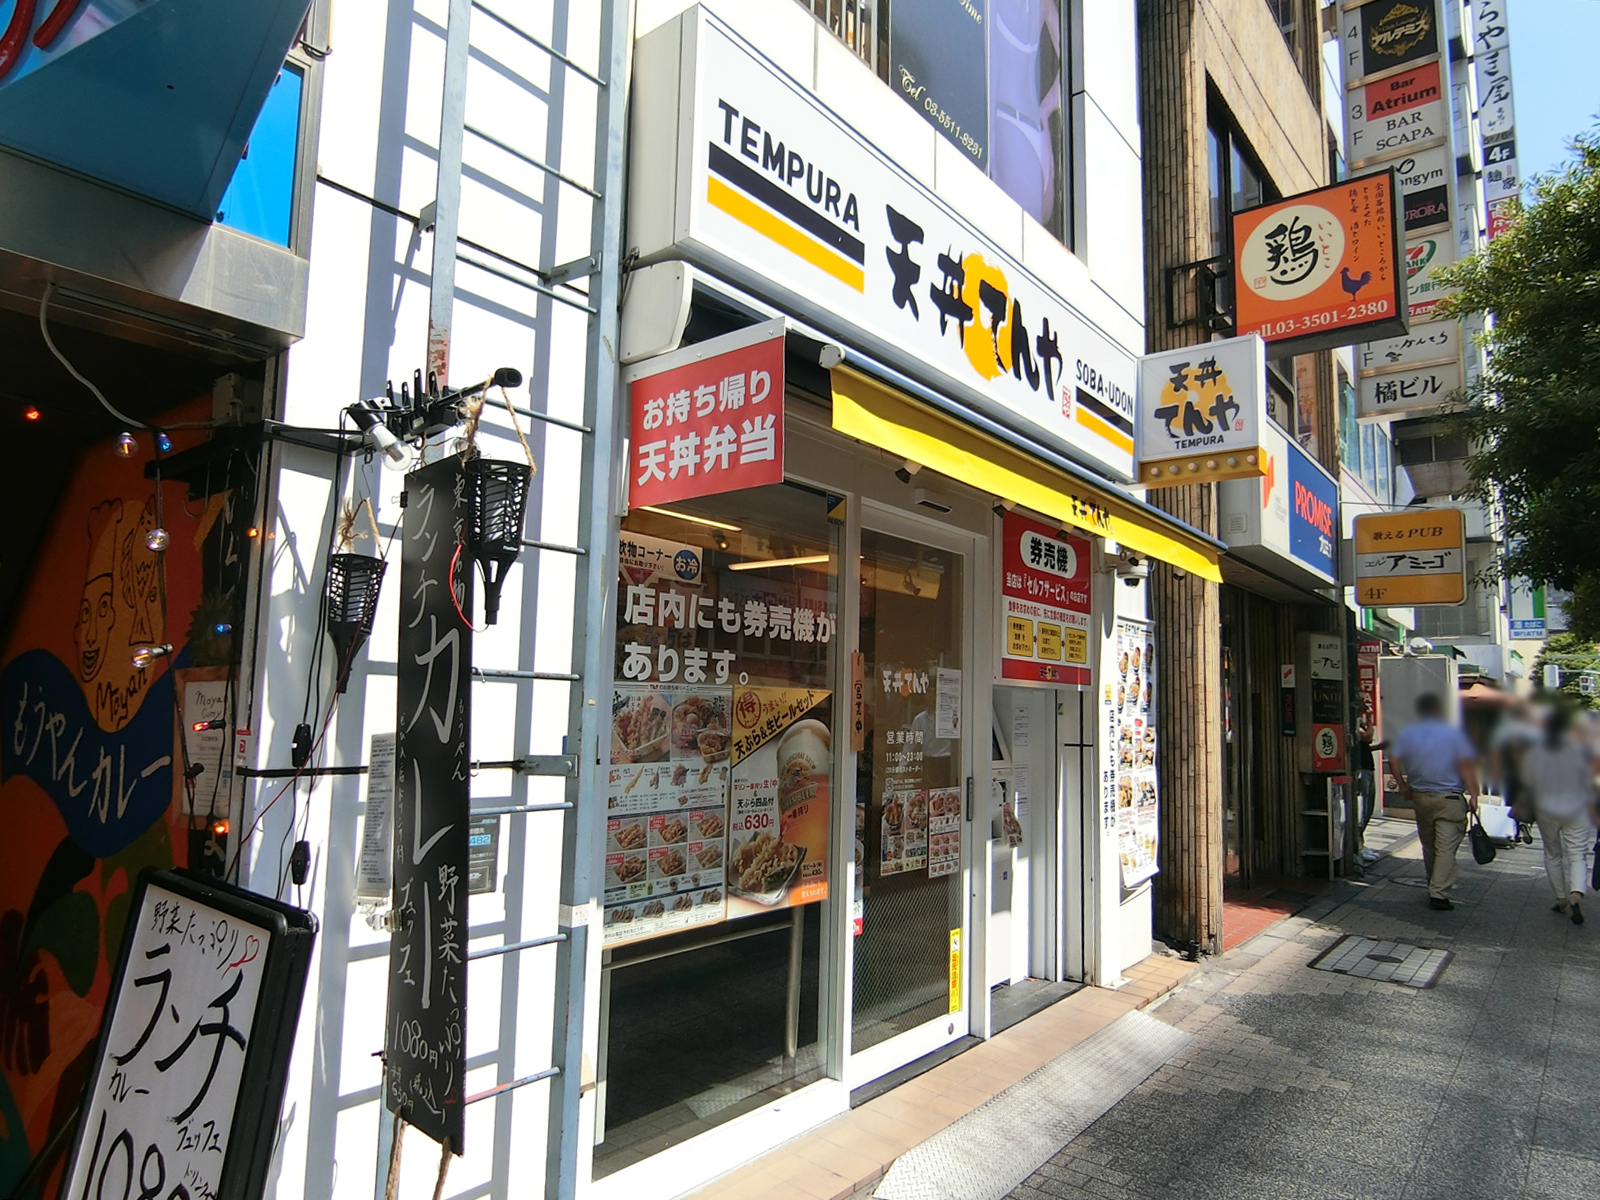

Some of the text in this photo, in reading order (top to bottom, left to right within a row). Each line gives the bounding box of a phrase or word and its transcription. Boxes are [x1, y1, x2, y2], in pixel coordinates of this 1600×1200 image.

[1371, 19, 1430, 50] アルテミス
[1371, 85, 1437, 116] Atrium
[1390, 77, 1416, 92] Bar
[898, 64, 983, 160] Tel 03-5511-8231
[1386, 111, 1423, 132] BAR
[1376, 126, 1435, 151] SCAPA
[1488, 147, 1510, 162] 4F
[718, 97, 860, 233] TEMPURA
[885, 203, 1063, 402] 天丼てんや
[1169, 354, 1222, 392] 天丼
[1374, 375, 1443, 405] 橘ビル
[642, 369, 772, 431] お持ち帰り
[1154, 393, 1240, 439] てんや
[637, 414, 776, 487] 天丼弁当
[1174, 434, 1225, 449] TEMPURA
[1294, 480, 1332, 538] PROMISE
[1372, 526, 1443, 541] 歌える PUB
[675, 556, 699, 575] お冷
[1030, 536, 1068, 574] 券売機
[1386, 551, 1452, 573] アミーゴ
[1364, 588, 1387, 600] 4F
[624, 583, 837, 644] 店内にも券売機が
[622, 641, 749, 685] あります。
[1360, 645, 1380, 653] ATM
[882, 669, 930, 695] 天丼てんや
[738, 690, 756, 719] 得
[734, 690, 815, 759] 天ぷら&生ビールセット
[886, 731, 924, 745] 営業時間
[13, 681, 172, 826] もうやんカレー
[737, 796, 775, 809] 天ぷら四品付
[732, 813, 775, 832] 税込630円
[151, 900, 239, 970] 野菜たっぷり
[438, 865, 463, 1097] 野菜たっぷり
[110, 942, 246, 1126] ランチ
[394, 1012, 438, 1070] 1080円
[108, 1068, 150, 1104] カレー
[82, 1108, 192, 1200] 108
